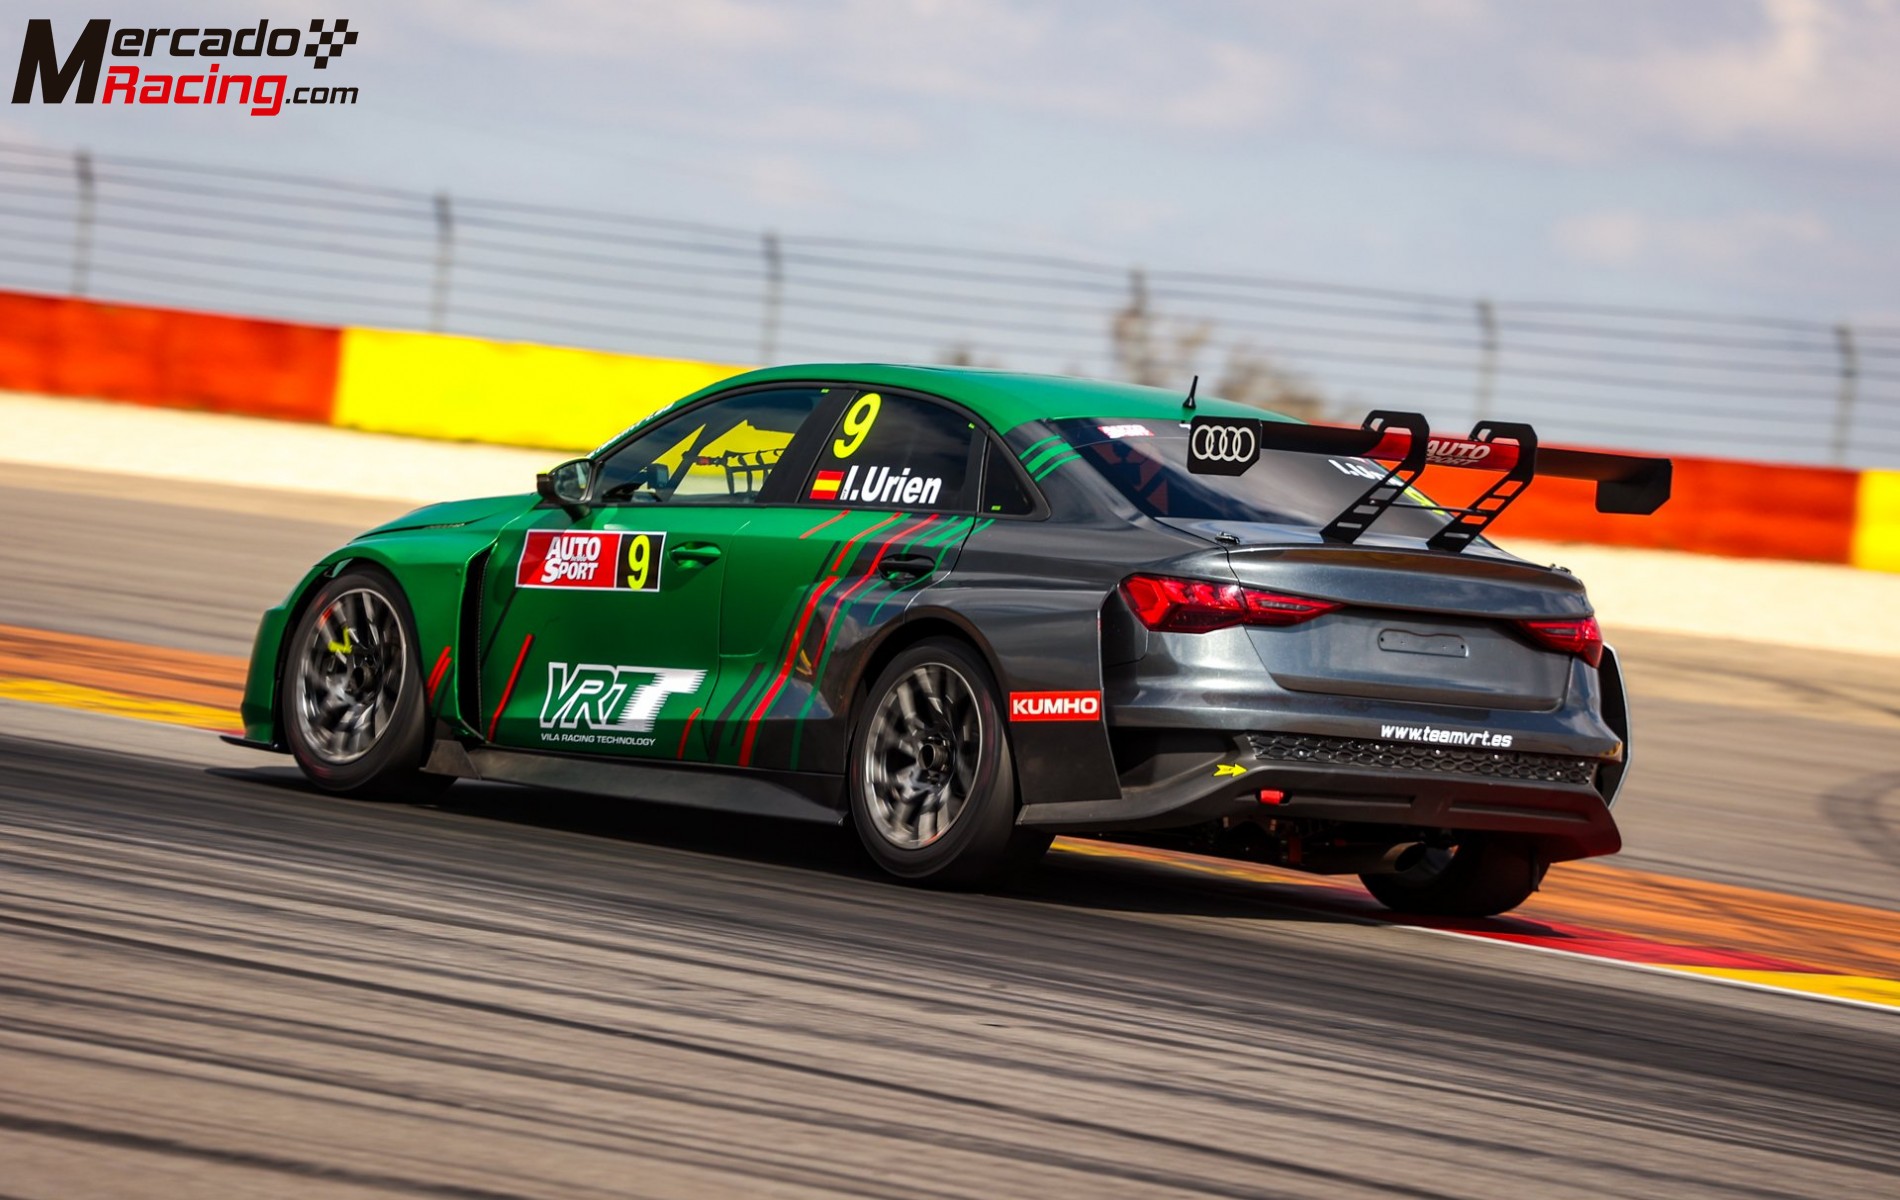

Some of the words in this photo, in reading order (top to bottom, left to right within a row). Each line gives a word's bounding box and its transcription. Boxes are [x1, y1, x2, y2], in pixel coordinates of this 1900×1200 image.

[833, 393, 881, 458] 9
[1425, 456, 1480, 466] PORT
[840, 465, 942, 504] I.Urien
[545, 536, 602, 561] AUTO
[540, 557, 599, 583] SPORT
[627, 535, 651, 590] 9
[540, 662, 708, 732] VRT
[1012, 697, 1098, 715] KUMHO
[541, 733, 560, 742] VILA
[561, 734, 595, 743] RACING
[596, 735, 656, 747] TECHNOLOGY
[1381, 725, 1513, 748] www.teamvrt.es
